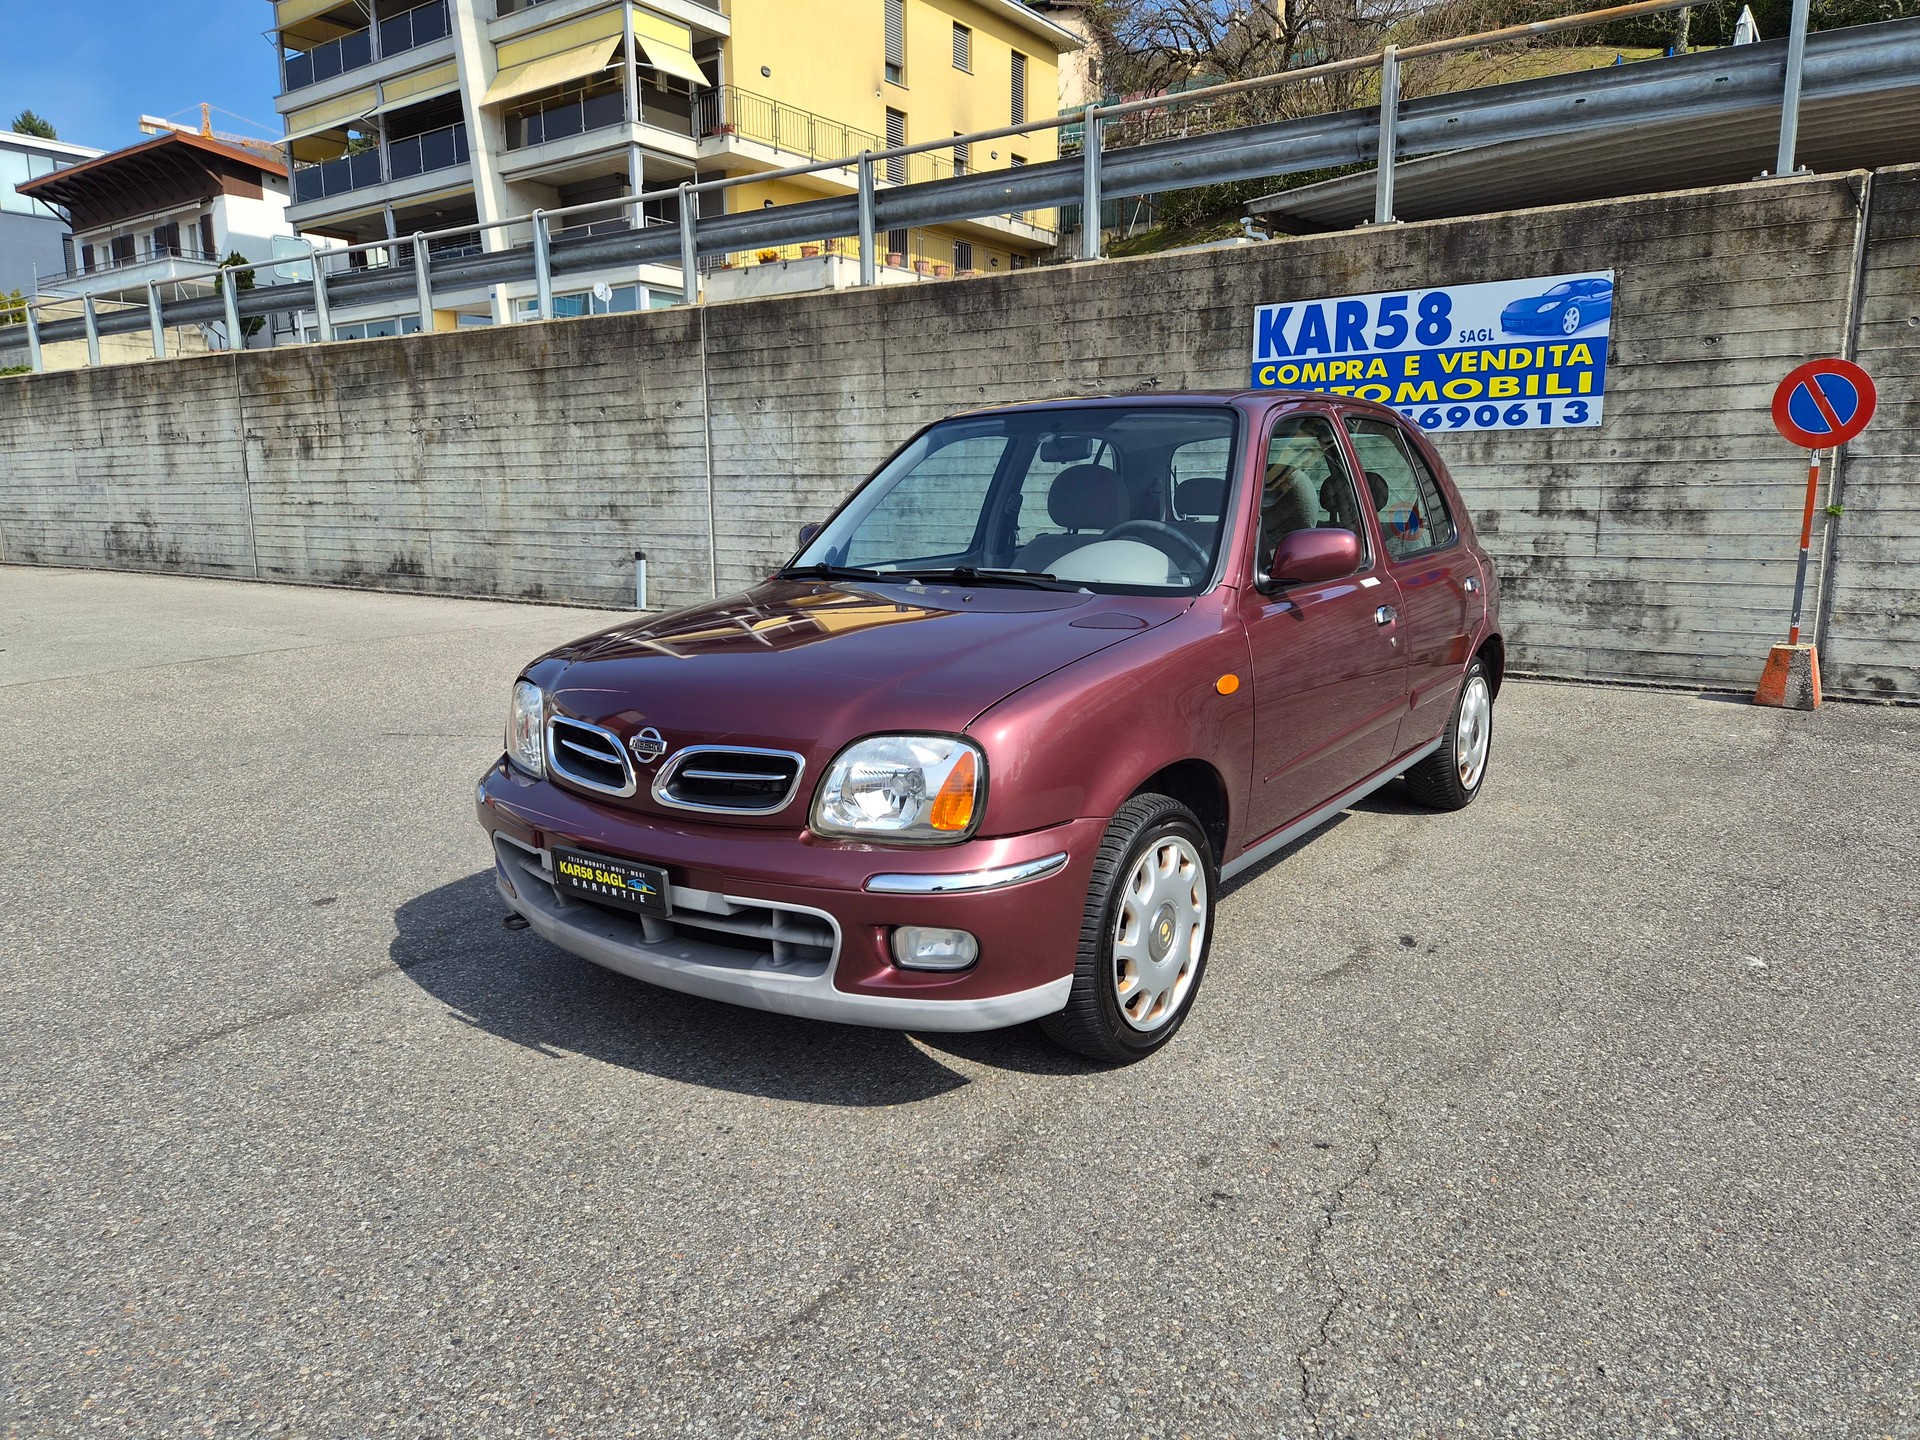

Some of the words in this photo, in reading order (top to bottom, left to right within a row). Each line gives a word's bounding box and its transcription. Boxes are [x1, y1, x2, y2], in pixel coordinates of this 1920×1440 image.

[1258, 291, 1453, 359] KAR58
[1459, 328, 1495, 344] SAGL
[1258, 358, 1389, 386] COMPRA
[1404, 355, 1421, 376] E
[1437, 343, 1594, 374] VENDITA
[1314, 371, 1593, 403] TOMOBILI
[632, 738, 662, 752] NISSAN
[560, 861, 593, 880] KAR58
[595, 870, 626, 888] SAGL
[572, 878, 645, 902] GARANTIE
